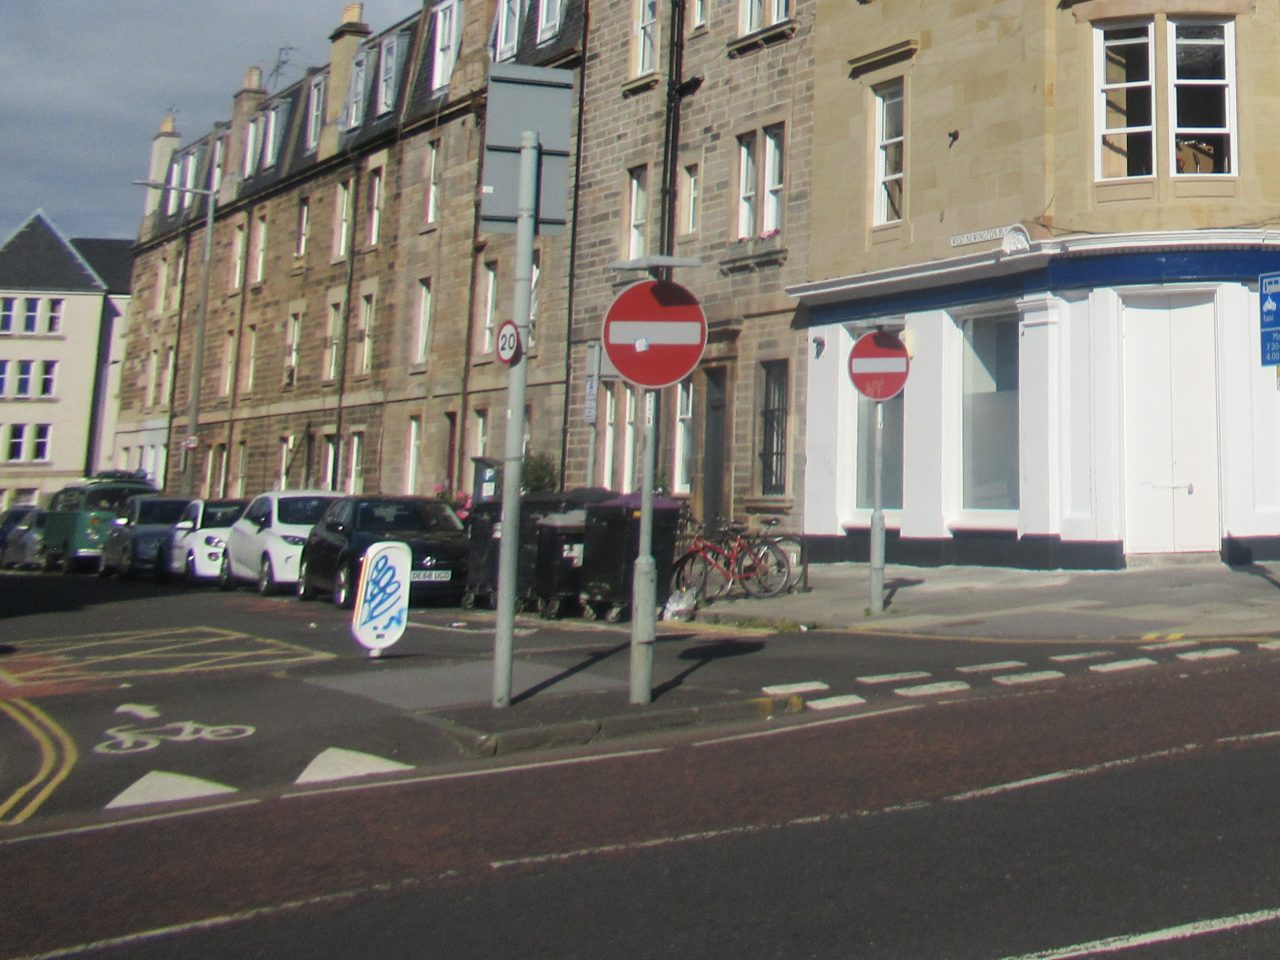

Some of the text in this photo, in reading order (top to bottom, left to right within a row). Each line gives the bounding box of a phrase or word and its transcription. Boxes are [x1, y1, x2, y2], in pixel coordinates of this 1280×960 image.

[1263, 314, 1274, 322] taxi
[500, 333, 515, 352] 20
[485, 468, 494, 480] P
